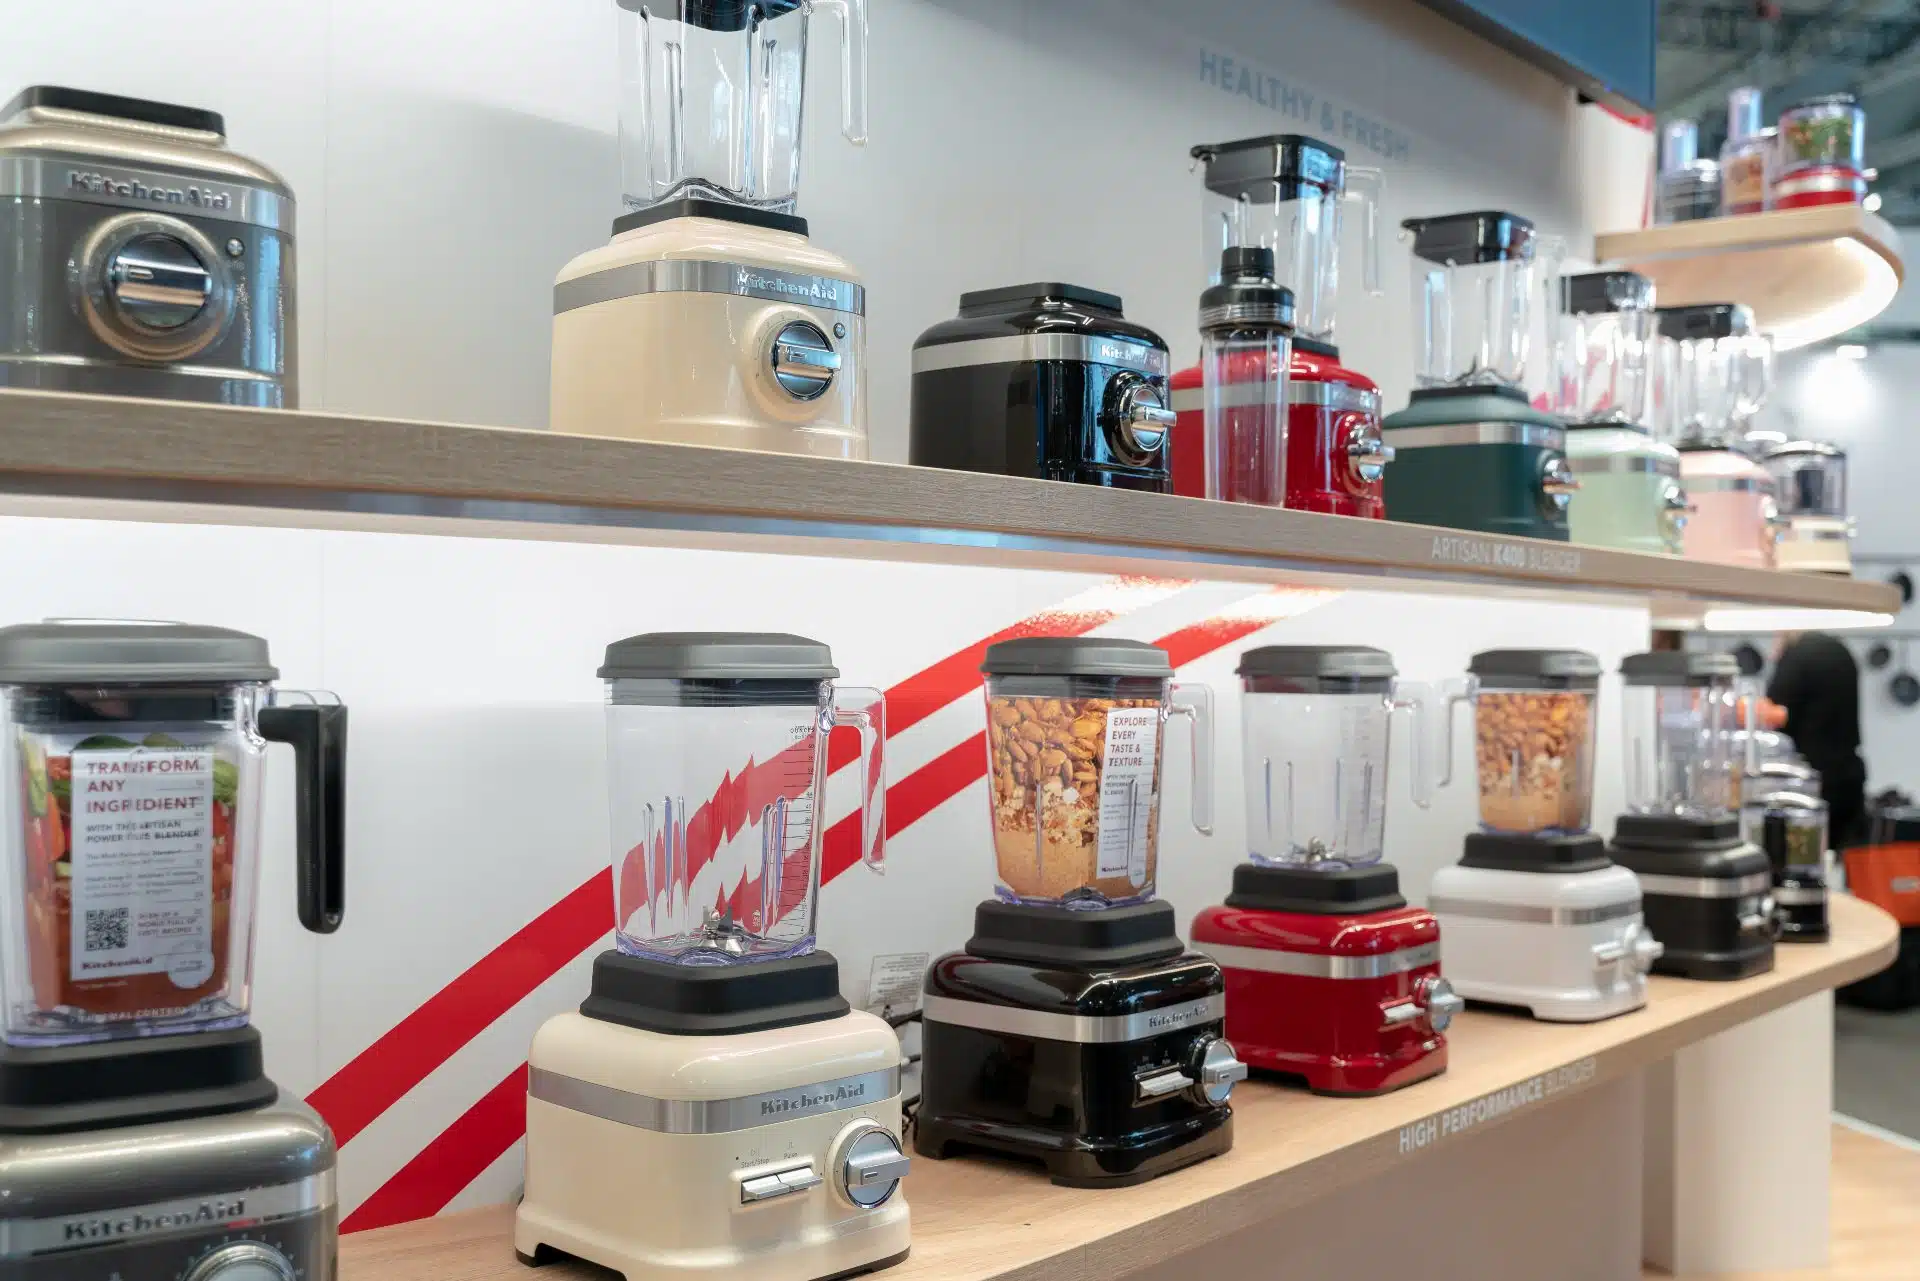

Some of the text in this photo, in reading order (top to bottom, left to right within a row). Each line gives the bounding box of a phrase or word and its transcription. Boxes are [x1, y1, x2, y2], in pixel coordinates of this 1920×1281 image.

[1200, 48, 1411, 161] HEALTHY & FRESH
[68, 171, 231, 209] KitchenAid
[738, 271, 837, 300] KitchenAid
[1432, 536, 1491, 565] ARTISAN
[1113, 717, 1148, 726] EXPLORE
[1112, 730, 1136, 740] EVERY
[1110, 743, 1140, 753] TASTE &
[86, 759, 200, 775] TRANSFORM
[1109, 757, 1143, 767] TEXTURE
[87, 779, 126, 793] ANY
[86, 797, 198, 814] INGREDIENT
[85, 824, 113, 833] WITH
[85, 834, 124, 843] POWER
[154, 829, 200, 840] BLENDER
[82, 957, 153, 970] KitchenAid
[1148, 1004, 1209, 1028] KitchenAid
[761, 1083, 864, 1116] KitchenAid
[1399, 1056, 1597, 1153] HIGH PERFORMANCE BLENDER
[740, 1158, 770, 1169] Start/Stop
[64, 1201, 245, 1240] KitchenAid
